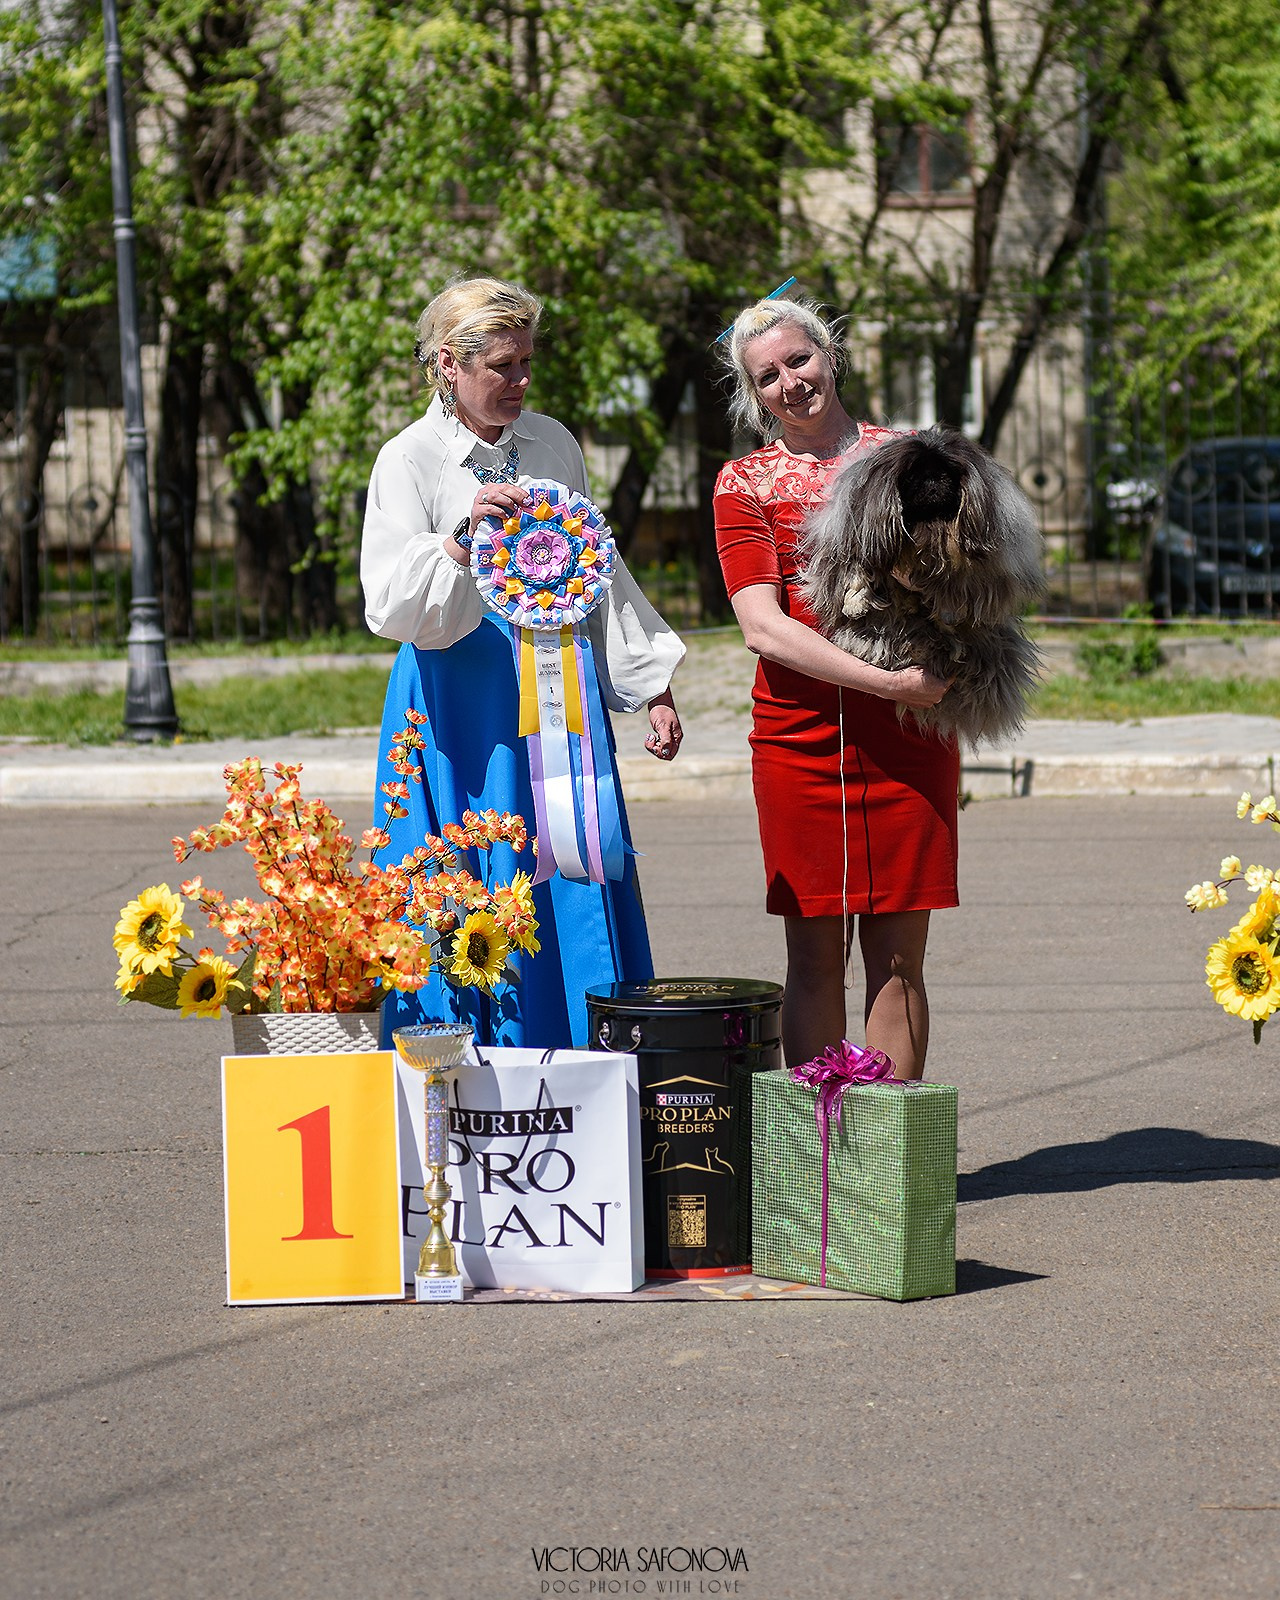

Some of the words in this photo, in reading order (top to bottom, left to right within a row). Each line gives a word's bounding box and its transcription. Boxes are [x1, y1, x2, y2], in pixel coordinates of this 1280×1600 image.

[667, 1095, 711, 1104] PURINA
[639, 1106, 677, 1122] PRO
[680, 1105, 732, 1122] PLAN
[453, 1110, 569, 1135] PURINA
[657, 1123, 715, 1134] BREEDERS
[277, 1104, 354, 1241] 1
